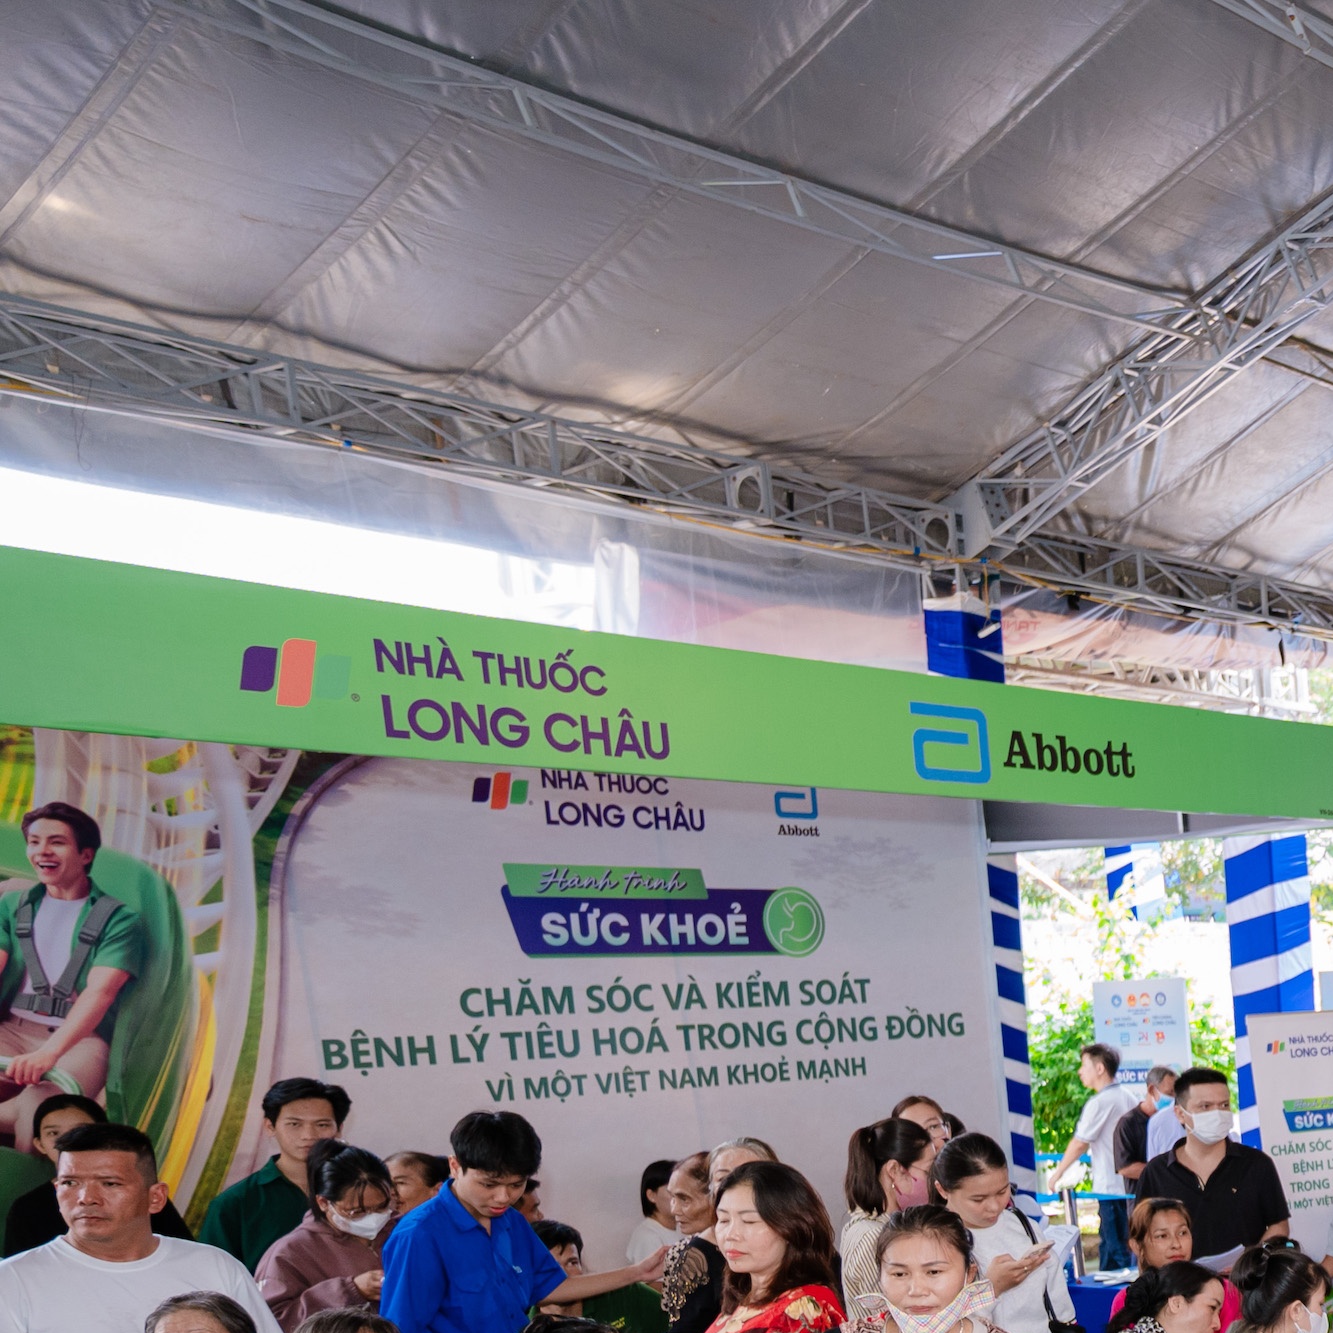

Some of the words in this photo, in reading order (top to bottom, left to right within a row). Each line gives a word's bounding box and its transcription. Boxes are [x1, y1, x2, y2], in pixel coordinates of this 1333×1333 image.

[373, 636, 464, 682] NHÀ
[472, 648, 608, 697] THUỐC
[381, 694, 530, 748] LONG
[544, 708, 671, 761] CHÂU
[1003, 730, 1136, 778] Abbott
[544, 800, 625, 828] LONG
[632, 801, 706, 832] CHÂU
[777, 824, 820, 837] Abbott
[536, 867, 618, 893] Hành
[540, 902, 631, 947] SỨC
[641, 901, 750, 946] KHOẺ
[459, 978, 576, 1018] CHĂM
[586, 976, 654, 1014] SÓC
[661, 974, 707, 1011] VÀ
[715, 969, 791, 1009] KIỂM
[798, 971, 871, 1007] SOÁT
[321, 1028, 437, 1077] BỆNH
[449, 1024, 491, 1064] LÝ
[500, 1021, 581, 1061] TIÊU
[592, 1017, 669, 1056] HOÁ
[676, 1019, 787, 1052] TRONG
[795, 1011, 878, 1050] CỘNG
[885, 1005, 966, 1040] ĐỒNG
[1289, 1034, 1304, 1045] NHÀ
[1307, 1032, 1333, 1044] THUỐC
[1290, 1046, 1318, 1058] LONG
[485, 1071, 516, 1103] VÌ
[523, 1069, 588, 1103] MỘT
[595, 1065, 650, 1098] VIỆT
[658, 1066, 720, 1091] NAM
[726, 1055, 791, 1085] KHOẺ
[796, 1056, 867, 1084] MẠNH
[1294, 1111, 1325, 1128] SỨC
[1270, 1138, 1306, 1157] CHĂM
[1309, 1138, 1332, 1152] SÓC
[1293, 1159, 1324, 1174] BỆNH
[1290, 1179, 1331, 1193] TRONG
[1294, 1197, 1313, 1210] MỘT
[1316, 1194, 1333, 1207] VIỆT
